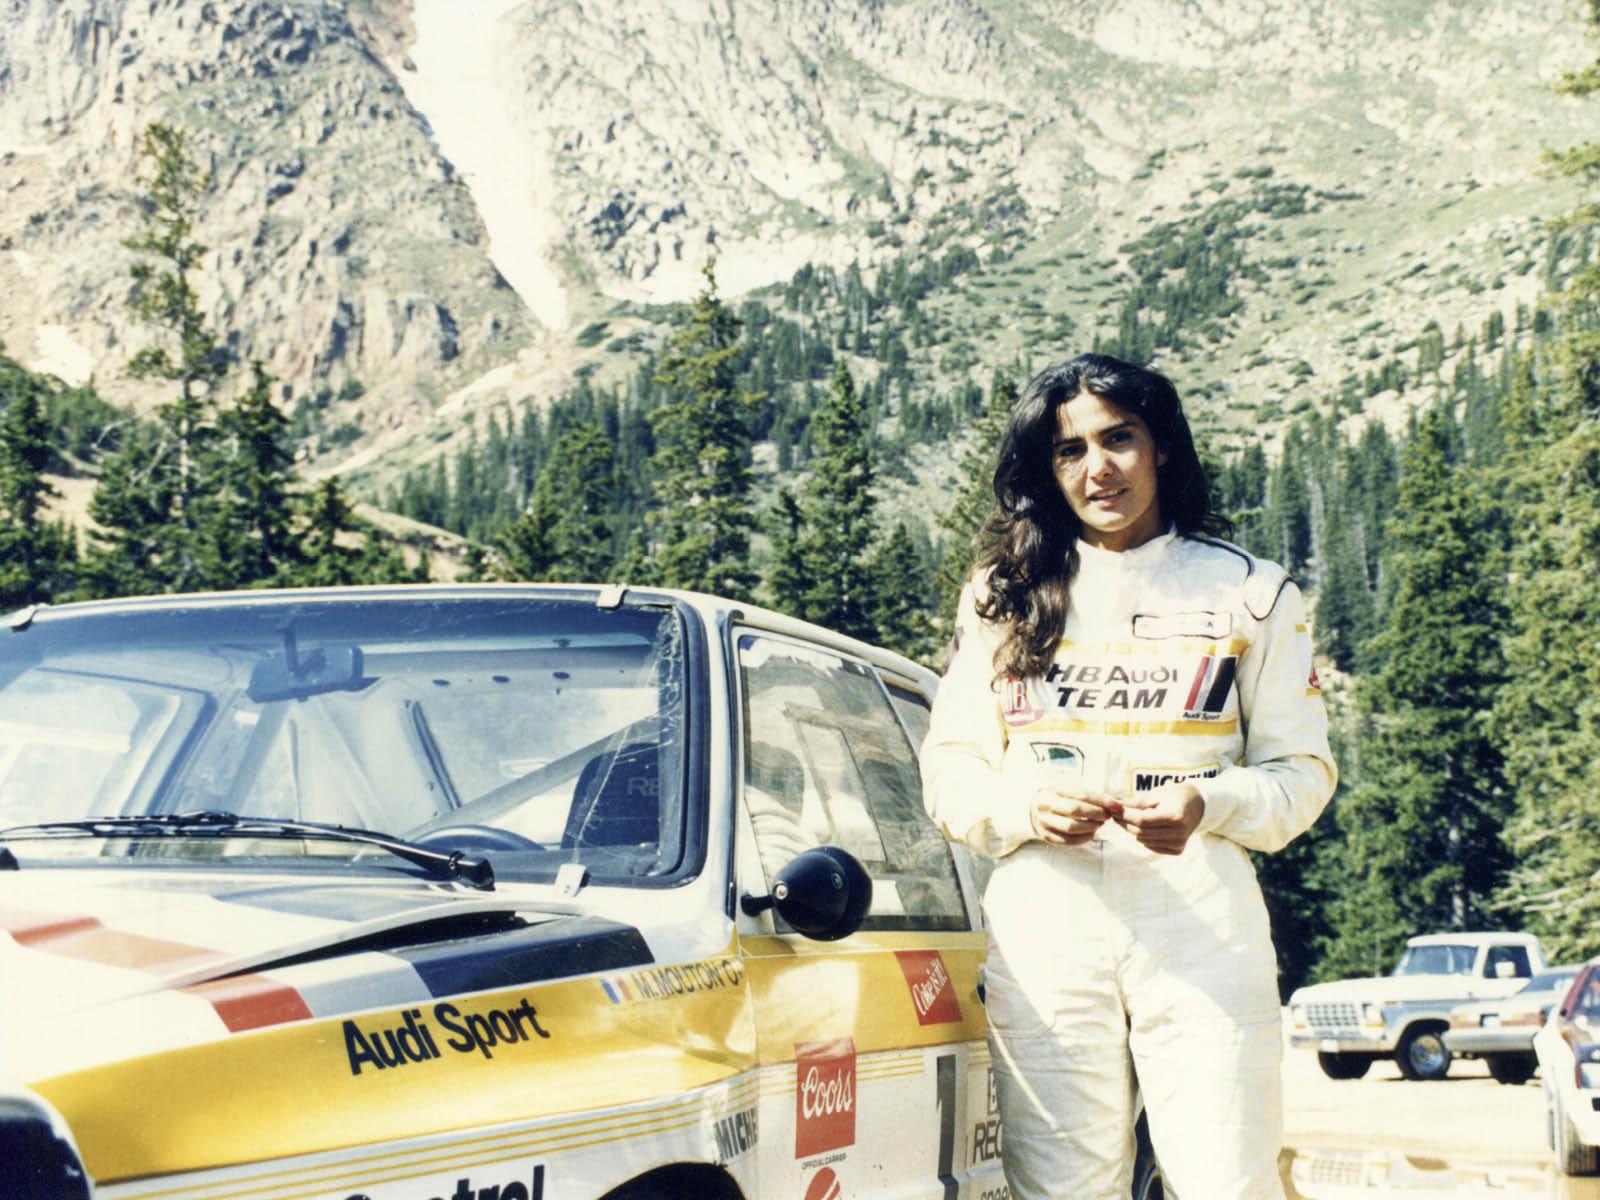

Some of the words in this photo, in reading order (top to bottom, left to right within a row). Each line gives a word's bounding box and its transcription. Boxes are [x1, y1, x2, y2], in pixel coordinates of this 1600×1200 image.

[1057, 686, 1168, 709] TEAM
[342, 1009, 441, 1076] Audi
[434, 998, 551, 1059] Sport
[801, 1066, 852, 1120] Coors
